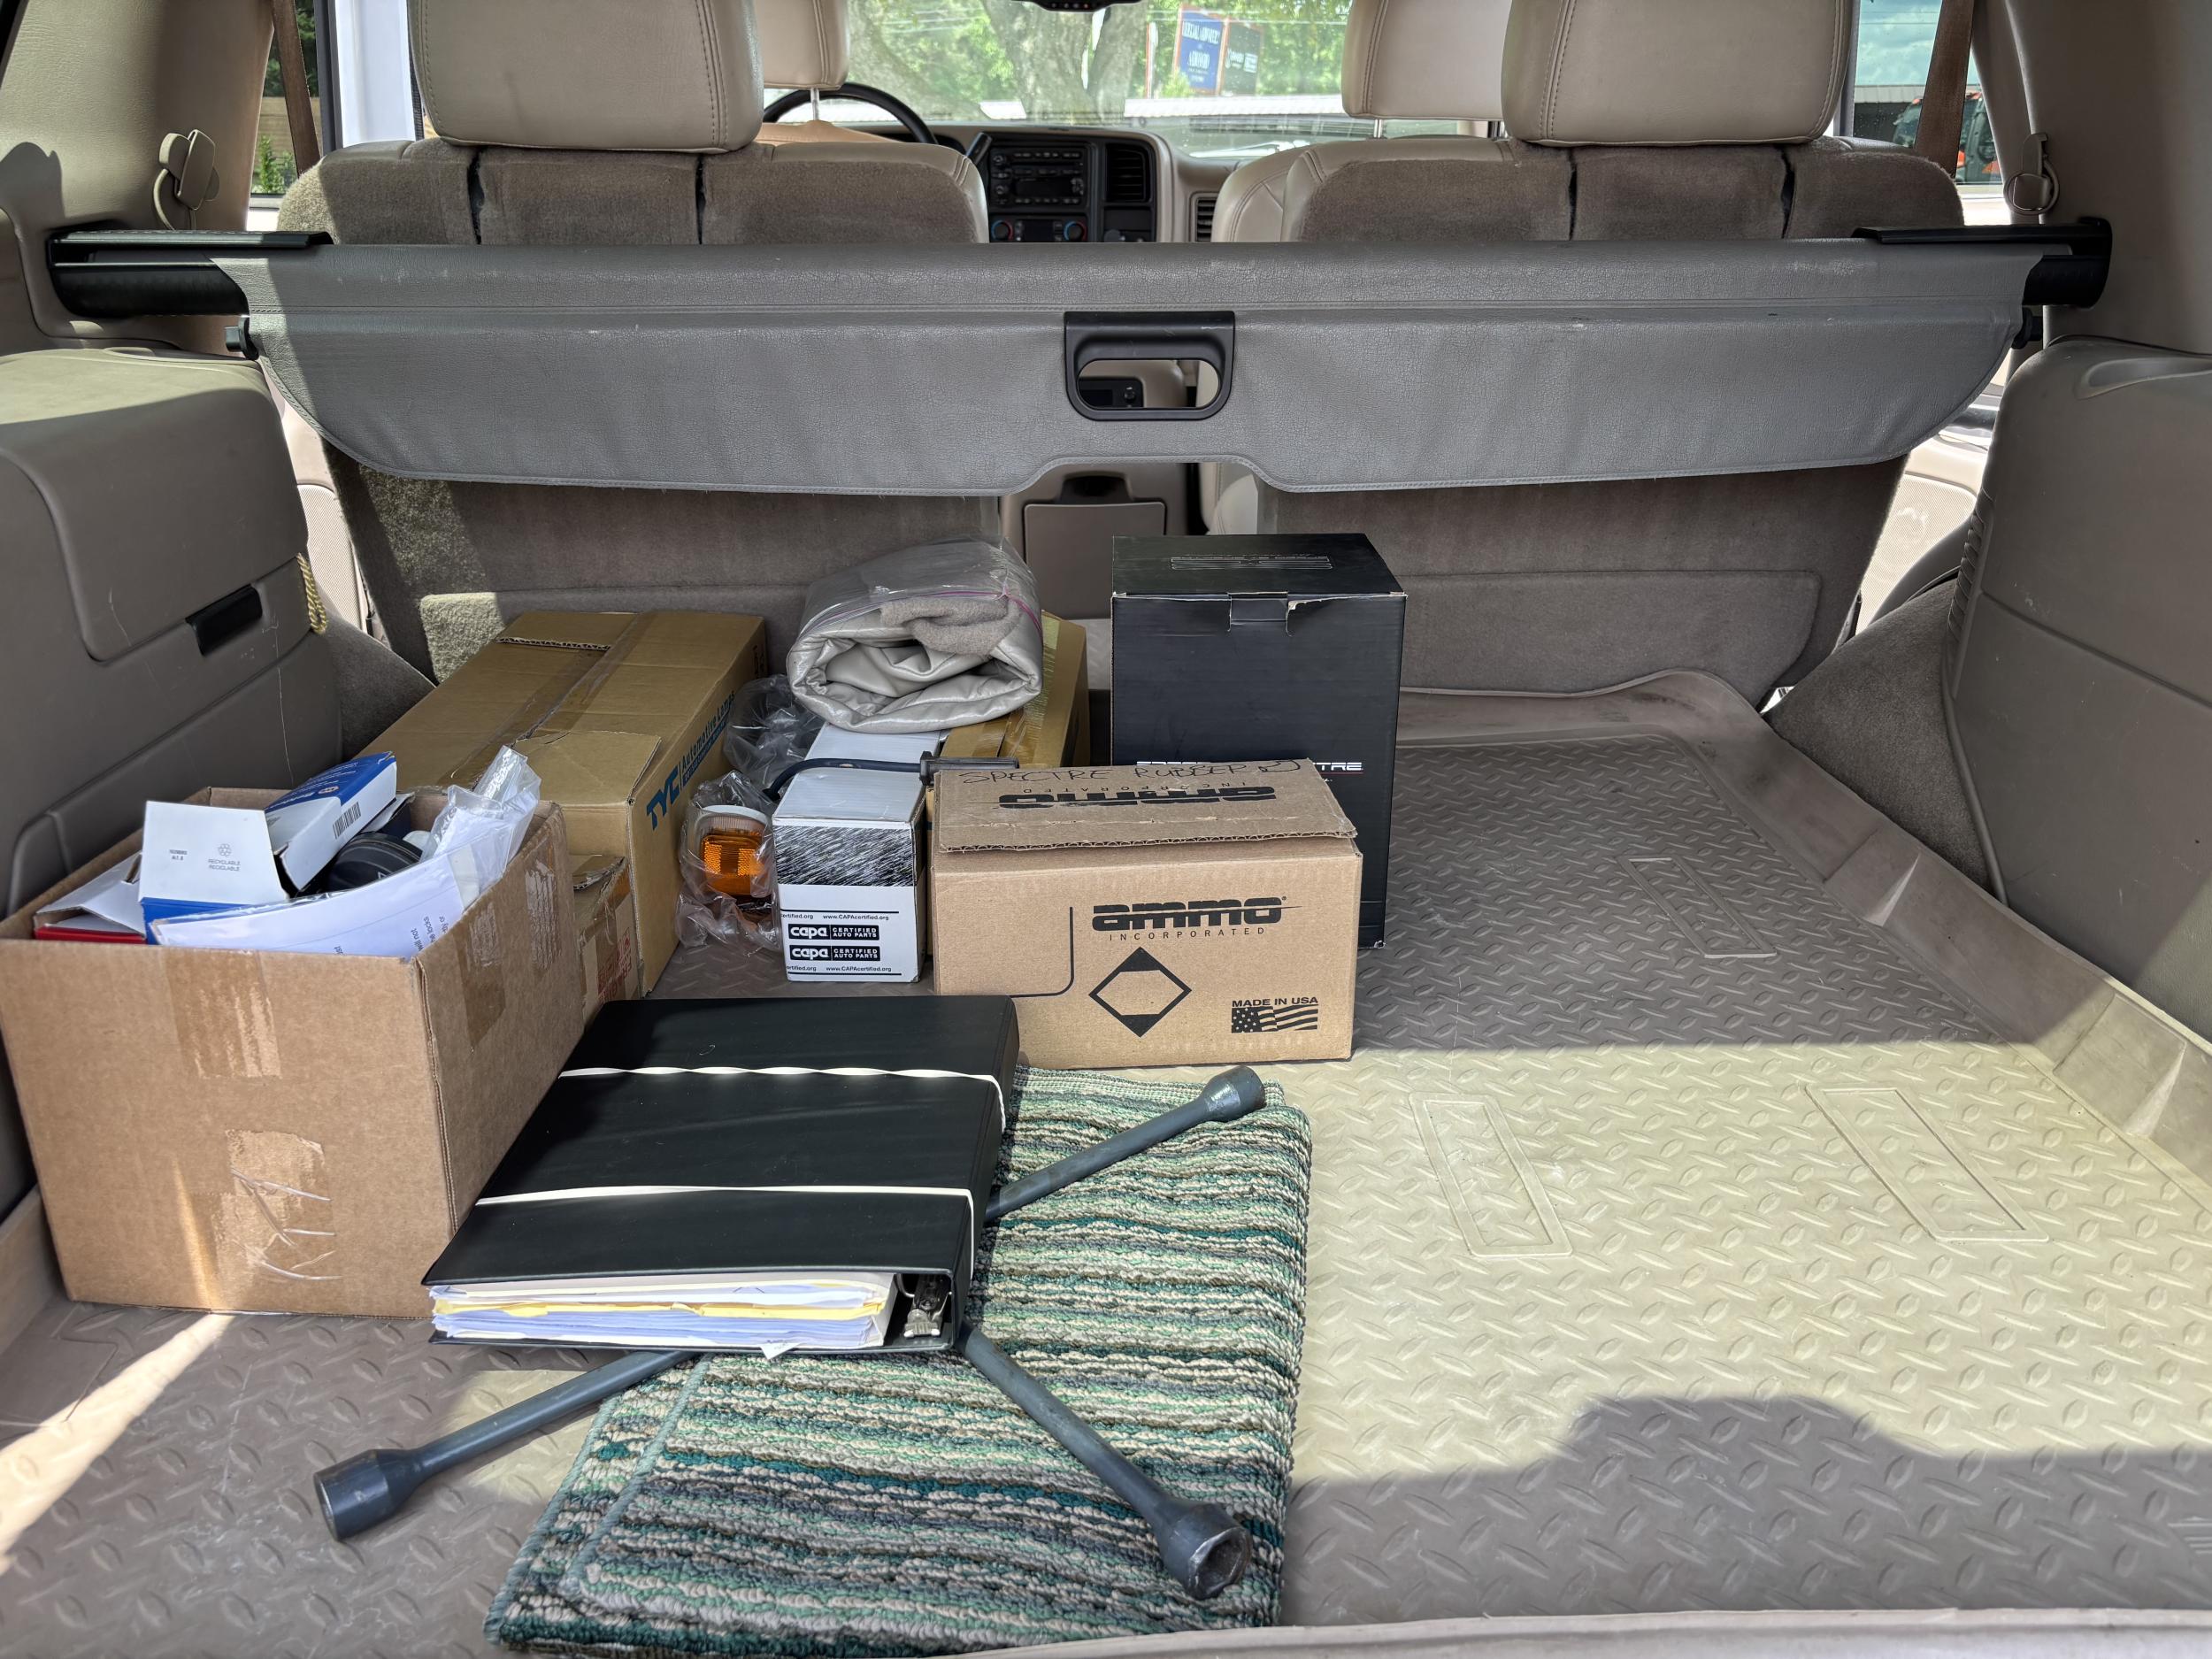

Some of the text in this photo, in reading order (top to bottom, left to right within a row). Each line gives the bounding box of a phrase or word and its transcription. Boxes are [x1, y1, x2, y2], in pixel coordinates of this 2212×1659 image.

[647, 764, 680, 831] TYC
[682, 714, 718, 772] Automotive
[1312, 762, 1363, 771] TRE
[959, 769, 1113, 784] SPECTRE
[1092, 897, 1283, 932] ammo
[790, 926, 829, 940] capa
[1110, 927, 1265, 941] INCORPORATED
[791, 948, 830, 960] capa
[1232, 996, 1318, 1008] MADE IN USA
